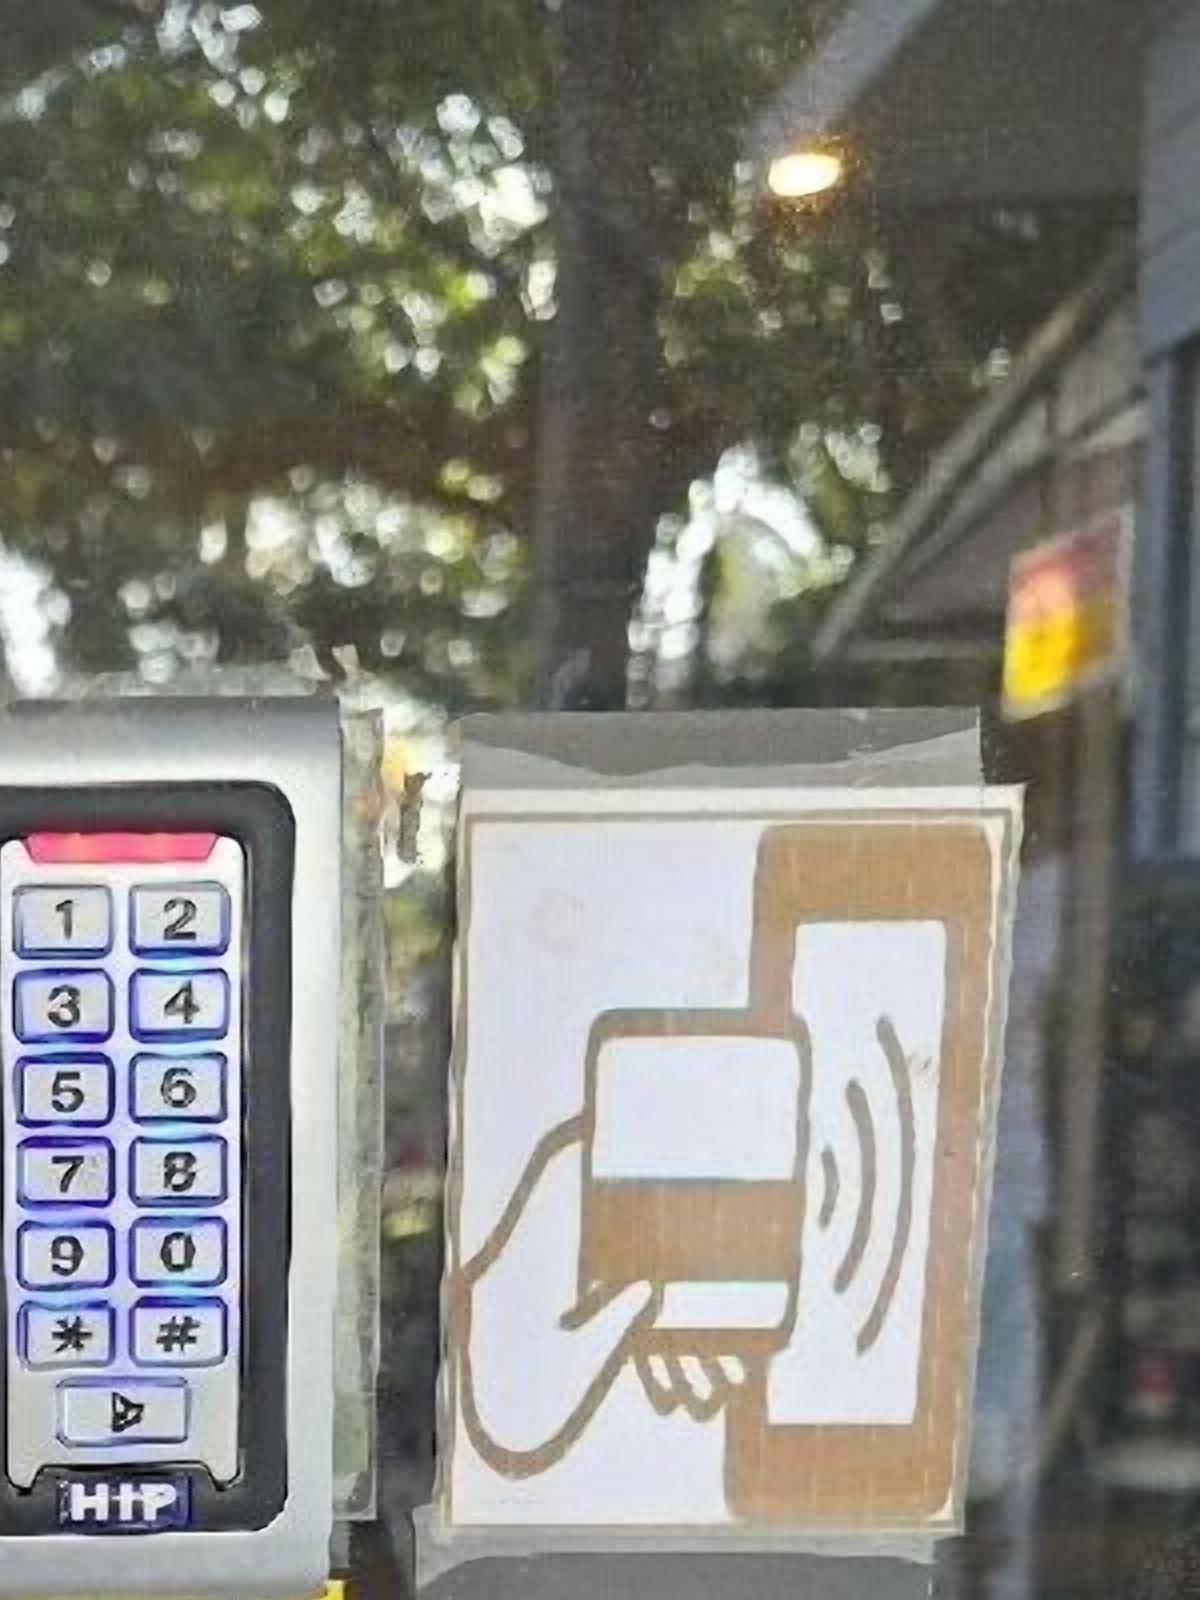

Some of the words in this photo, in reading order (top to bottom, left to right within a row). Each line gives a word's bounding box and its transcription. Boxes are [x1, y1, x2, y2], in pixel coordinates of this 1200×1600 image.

[54, 899, 75, 940] 1
[162, 897, 198, 941] 2
[47, 984, 81, 1029] 3
[162, 979, 201, 1025] 4
[51, 1071, 86, 1114] 5
[160, 1067, 197, 1109] 6
[51, 1155, 85, 1194] 7
[162, 1150, 198, 1193] 8
[50, 1234, 85, 1278] 9
[158, 1230, 197, 1274] 0
[69, 1482, 178, 1522] HIP
